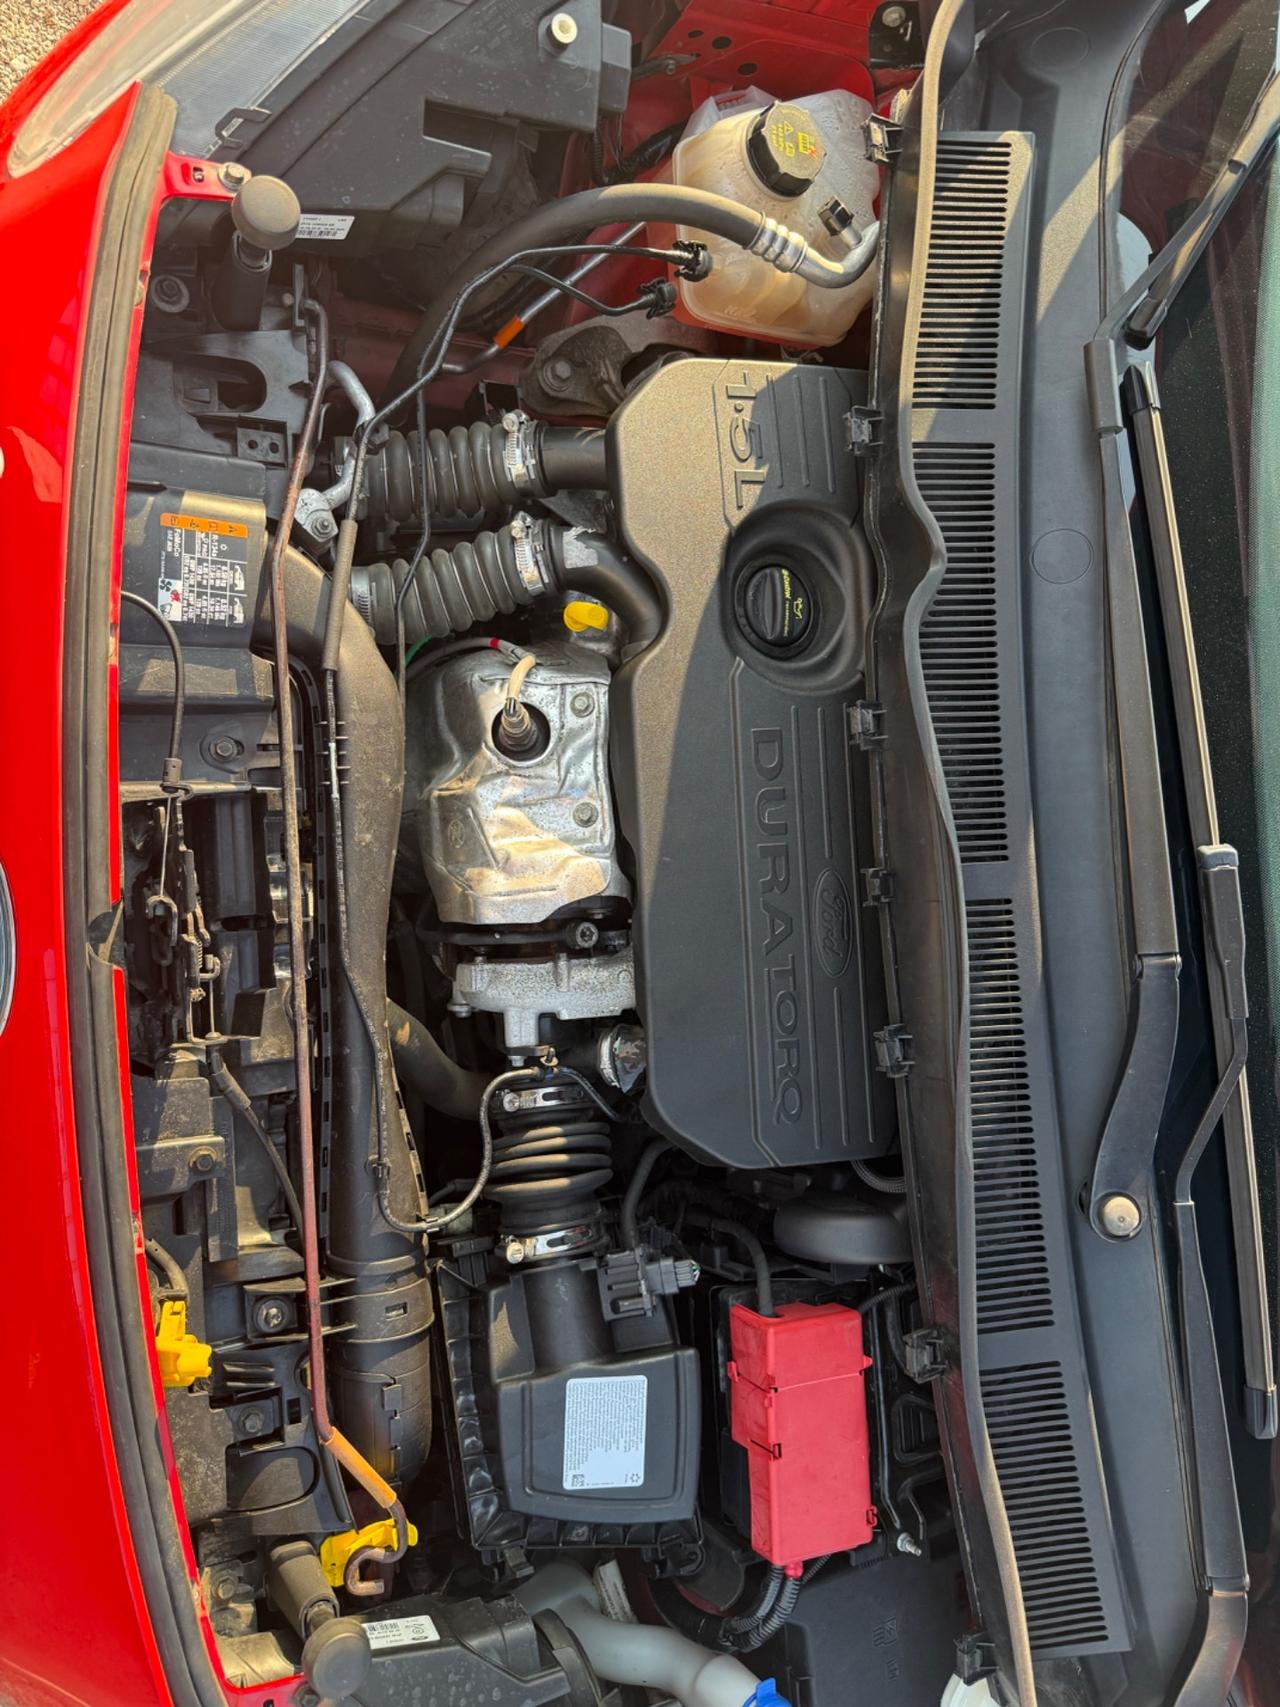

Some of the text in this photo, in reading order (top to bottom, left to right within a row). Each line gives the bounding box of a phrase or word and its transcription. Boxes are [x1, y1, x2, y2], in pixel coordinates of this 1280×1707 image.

[725, 371, 767, 511] 1.5L
[750, 727, 804, 1127] DURATORQ
[820, 887, 849, 957] Ford
